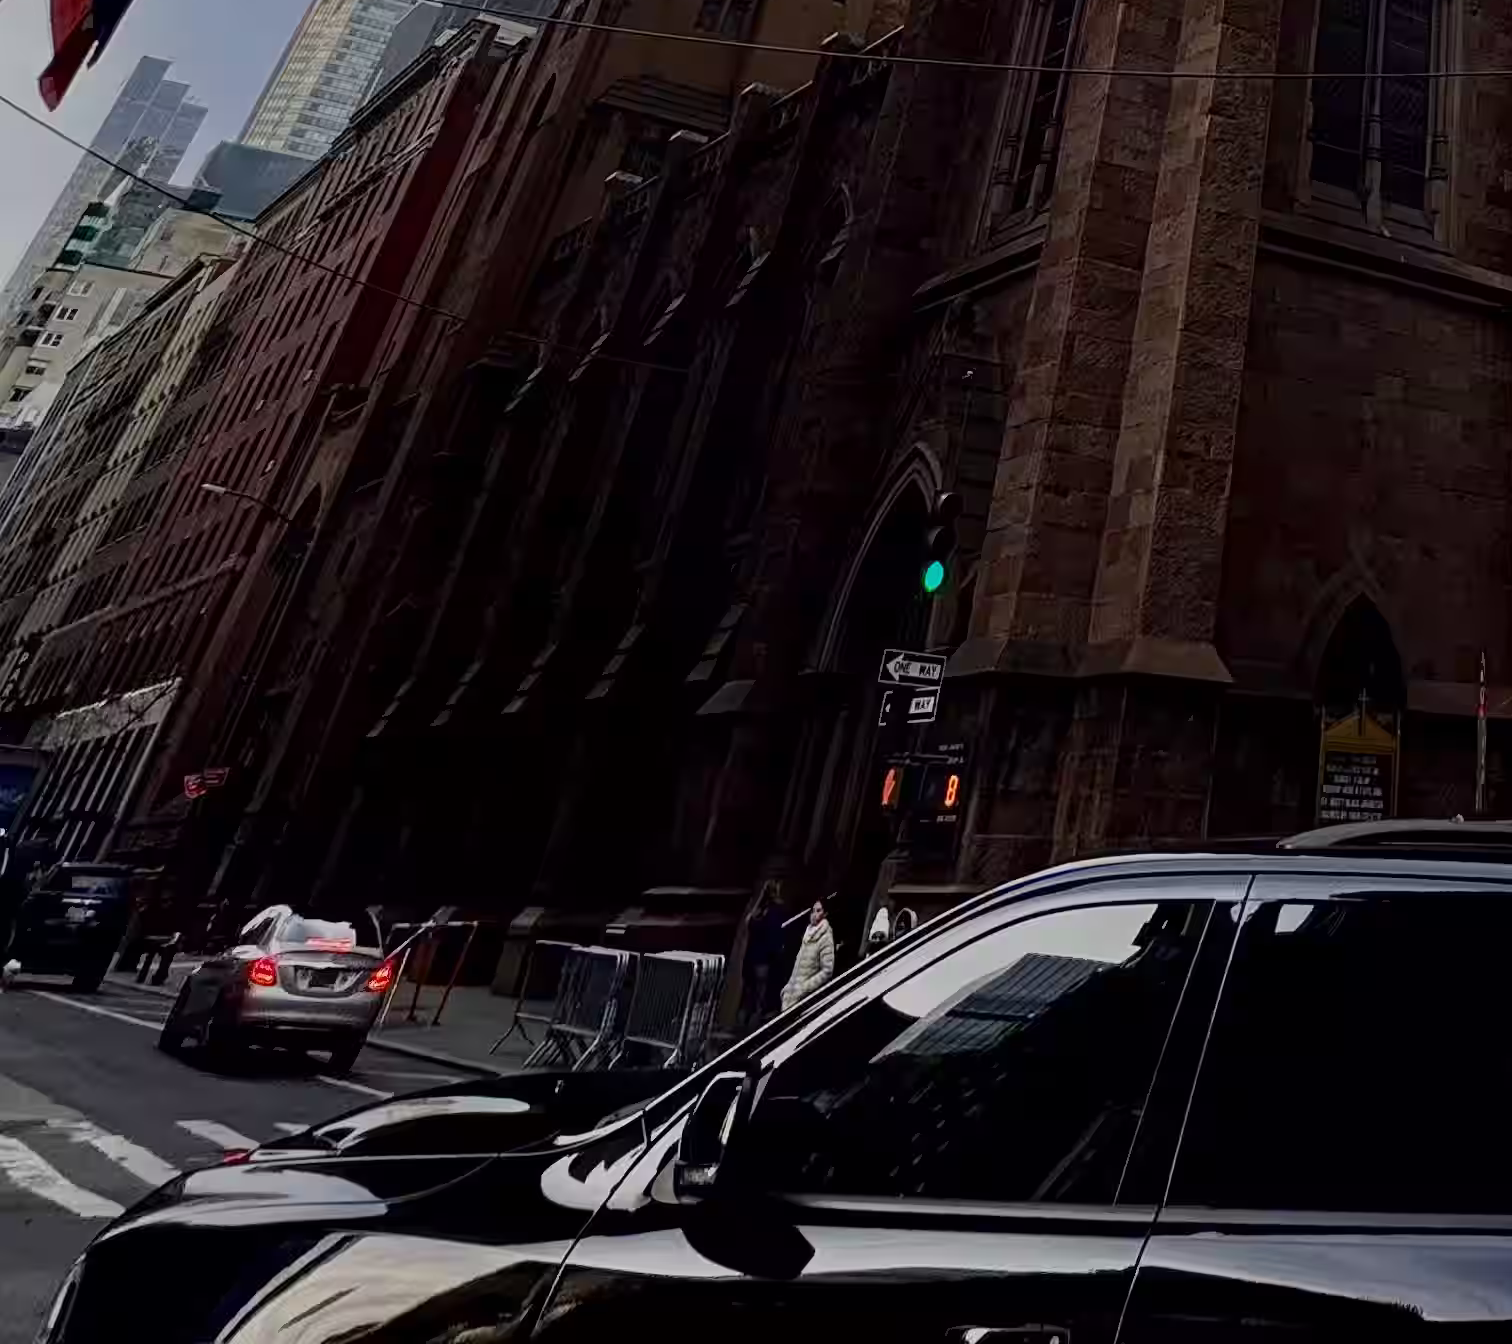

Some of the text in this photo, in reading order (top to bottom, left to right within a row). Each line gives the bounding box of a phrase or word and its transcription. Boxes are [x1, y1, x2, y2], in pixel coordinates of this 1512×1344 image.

[893, 661, 938, 678] ONE WAY
[914, 699, 931, 710] WAY
